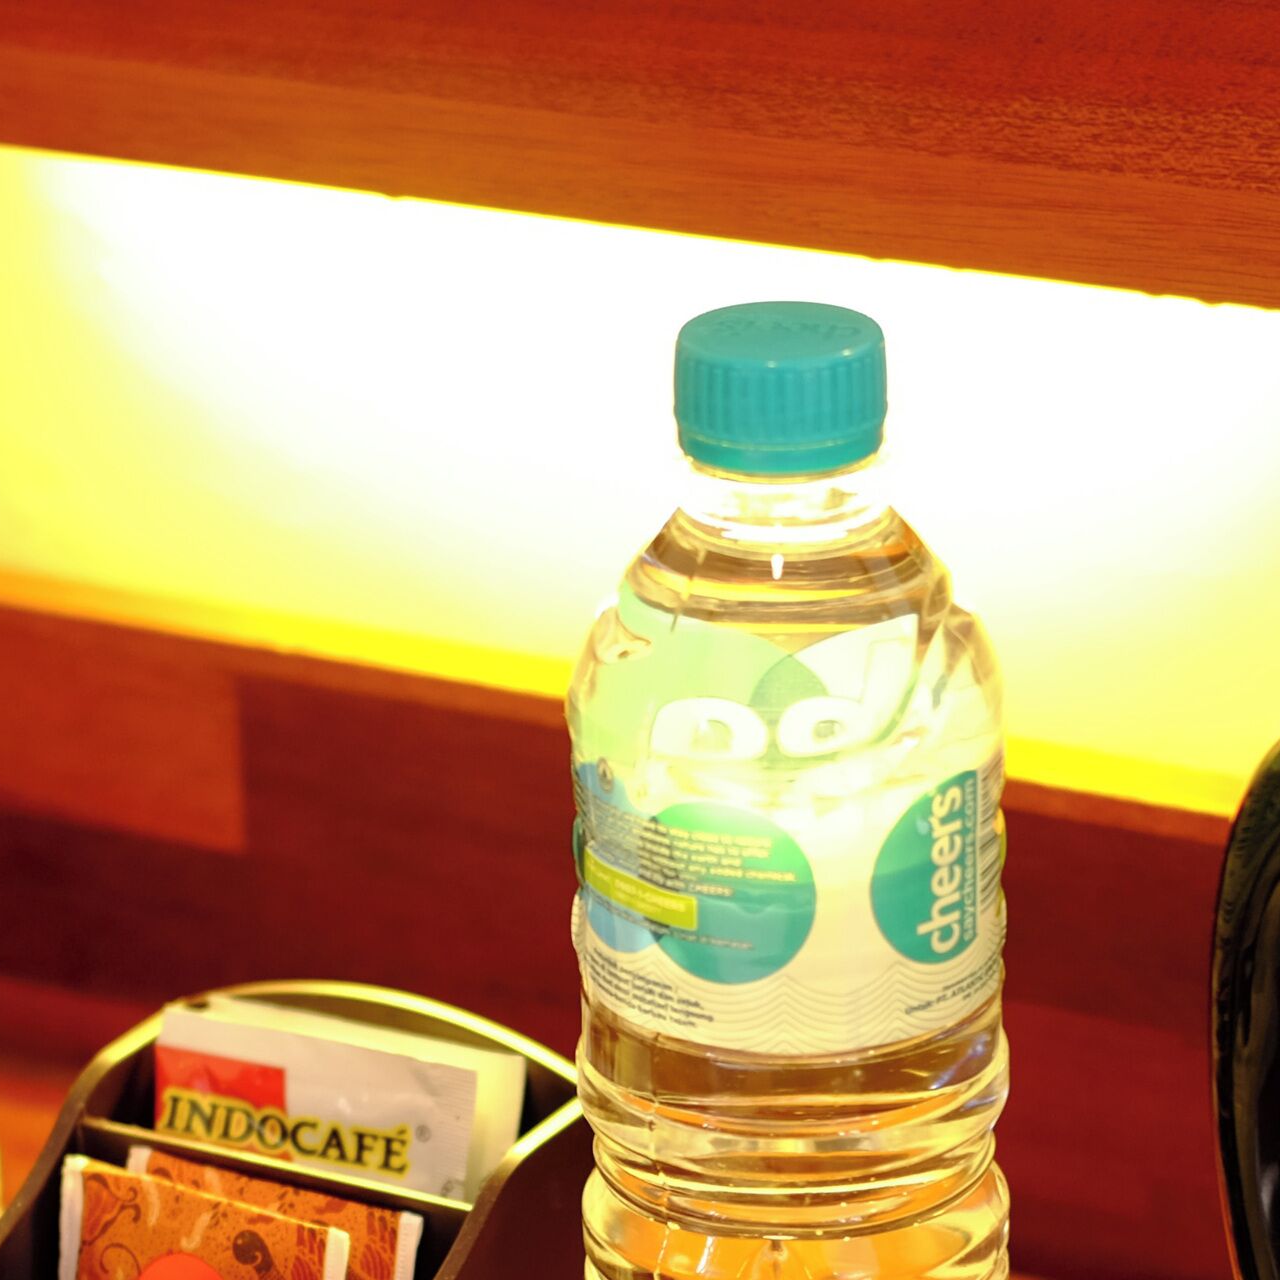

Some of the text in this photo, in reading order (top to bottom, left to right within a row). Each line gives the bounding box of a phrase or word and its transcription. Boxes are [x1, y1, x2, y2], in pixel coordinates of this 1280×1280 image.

[915, 785, 963, 955] cheers
[963, 778, 978, 942] saycheers.com
[164, 1094, 409, 1175] INDOCAFÉ
